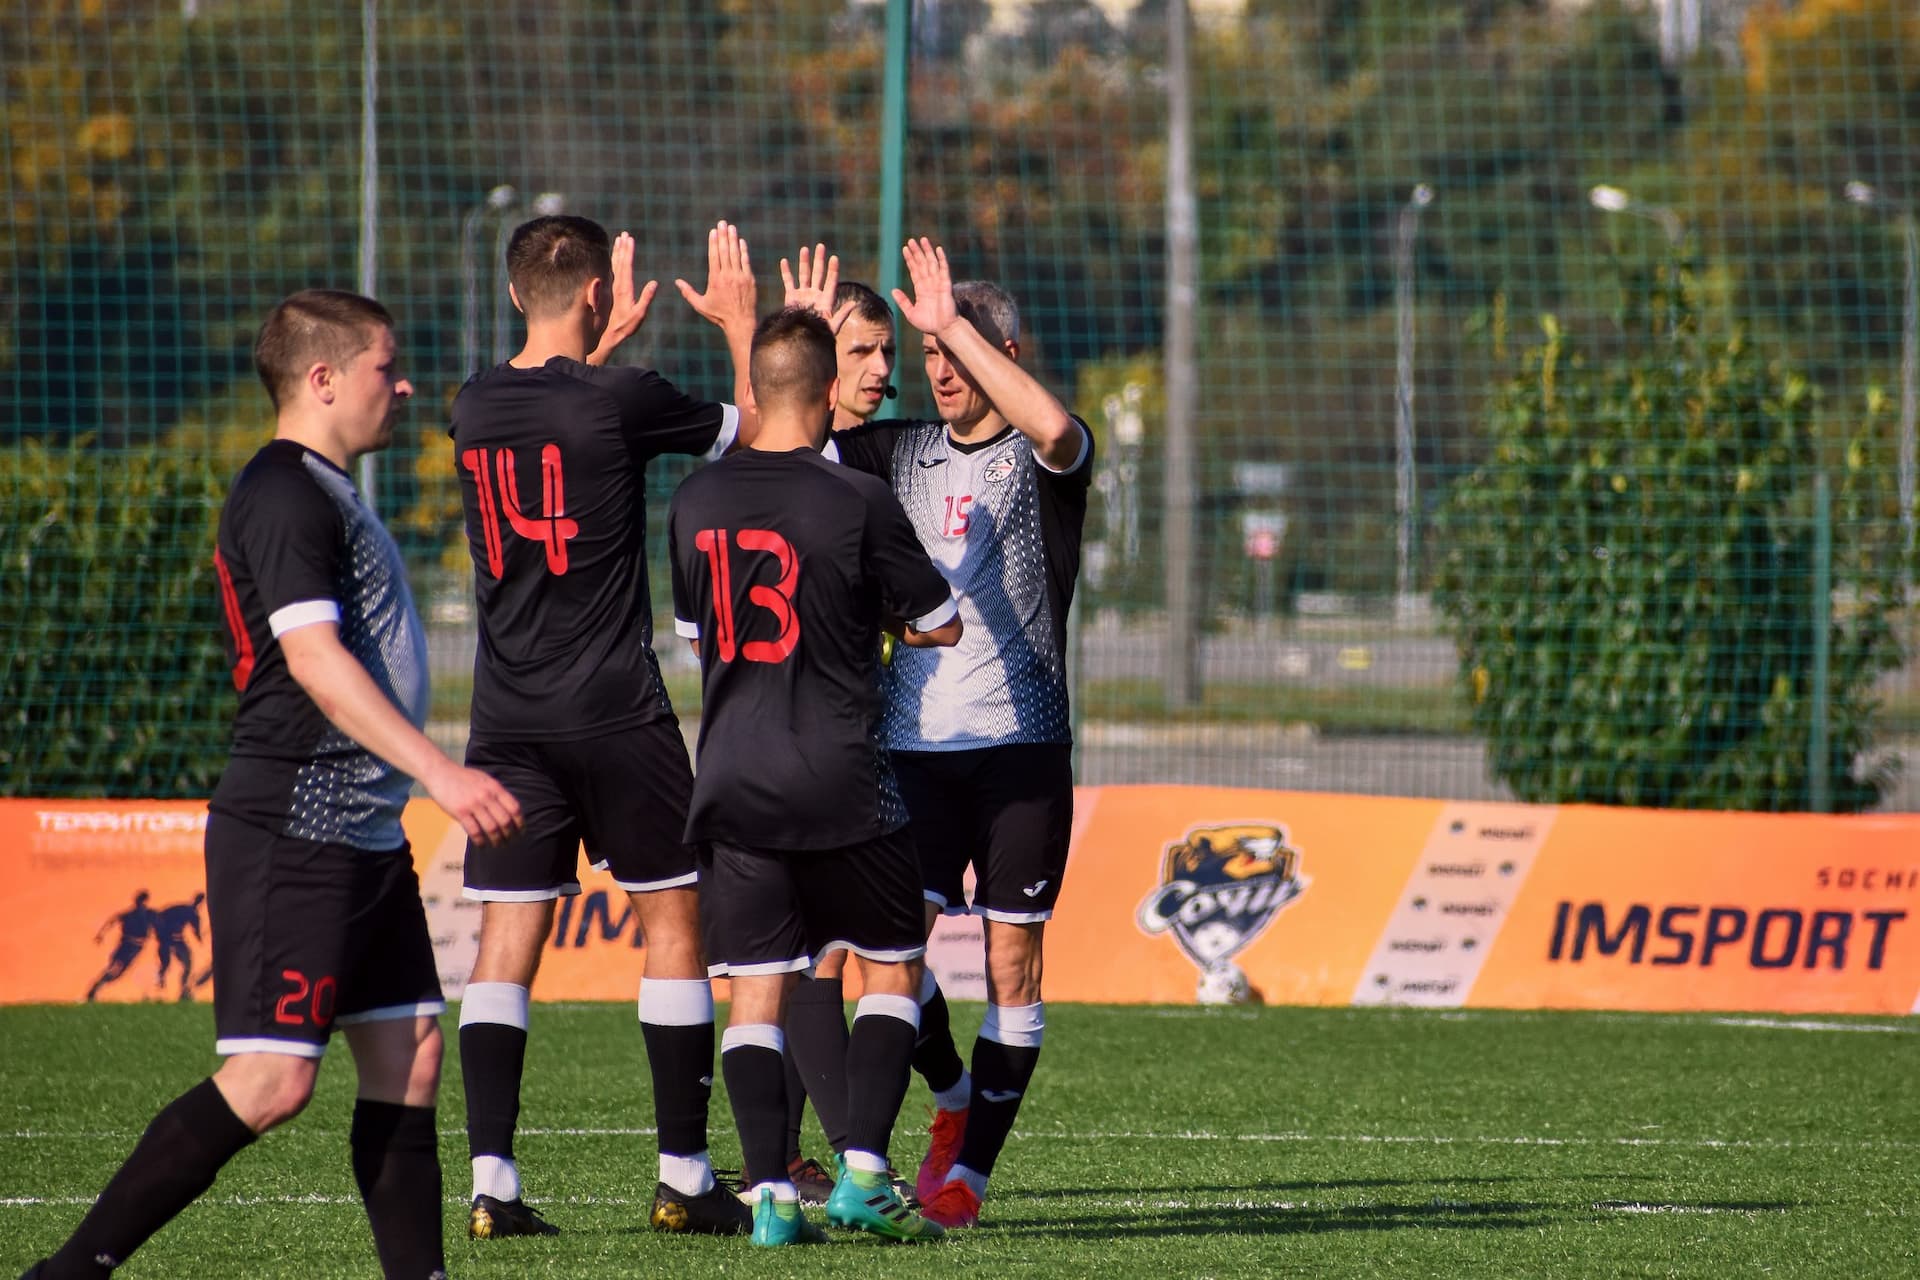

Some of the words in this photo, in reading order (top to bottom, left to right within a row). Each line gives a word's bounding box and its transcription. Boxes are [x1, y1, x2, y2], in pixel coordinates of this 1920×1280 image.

[462, 443, 579, 579] 14
[943, 495, 972, 537] 15
[696, 528, 801, 664] 13
[1817, 867, 1919, 889] SOCHI
[1548, 900, 1906, 970] IMSPORT
[275, 969, 336, 1028] 20
